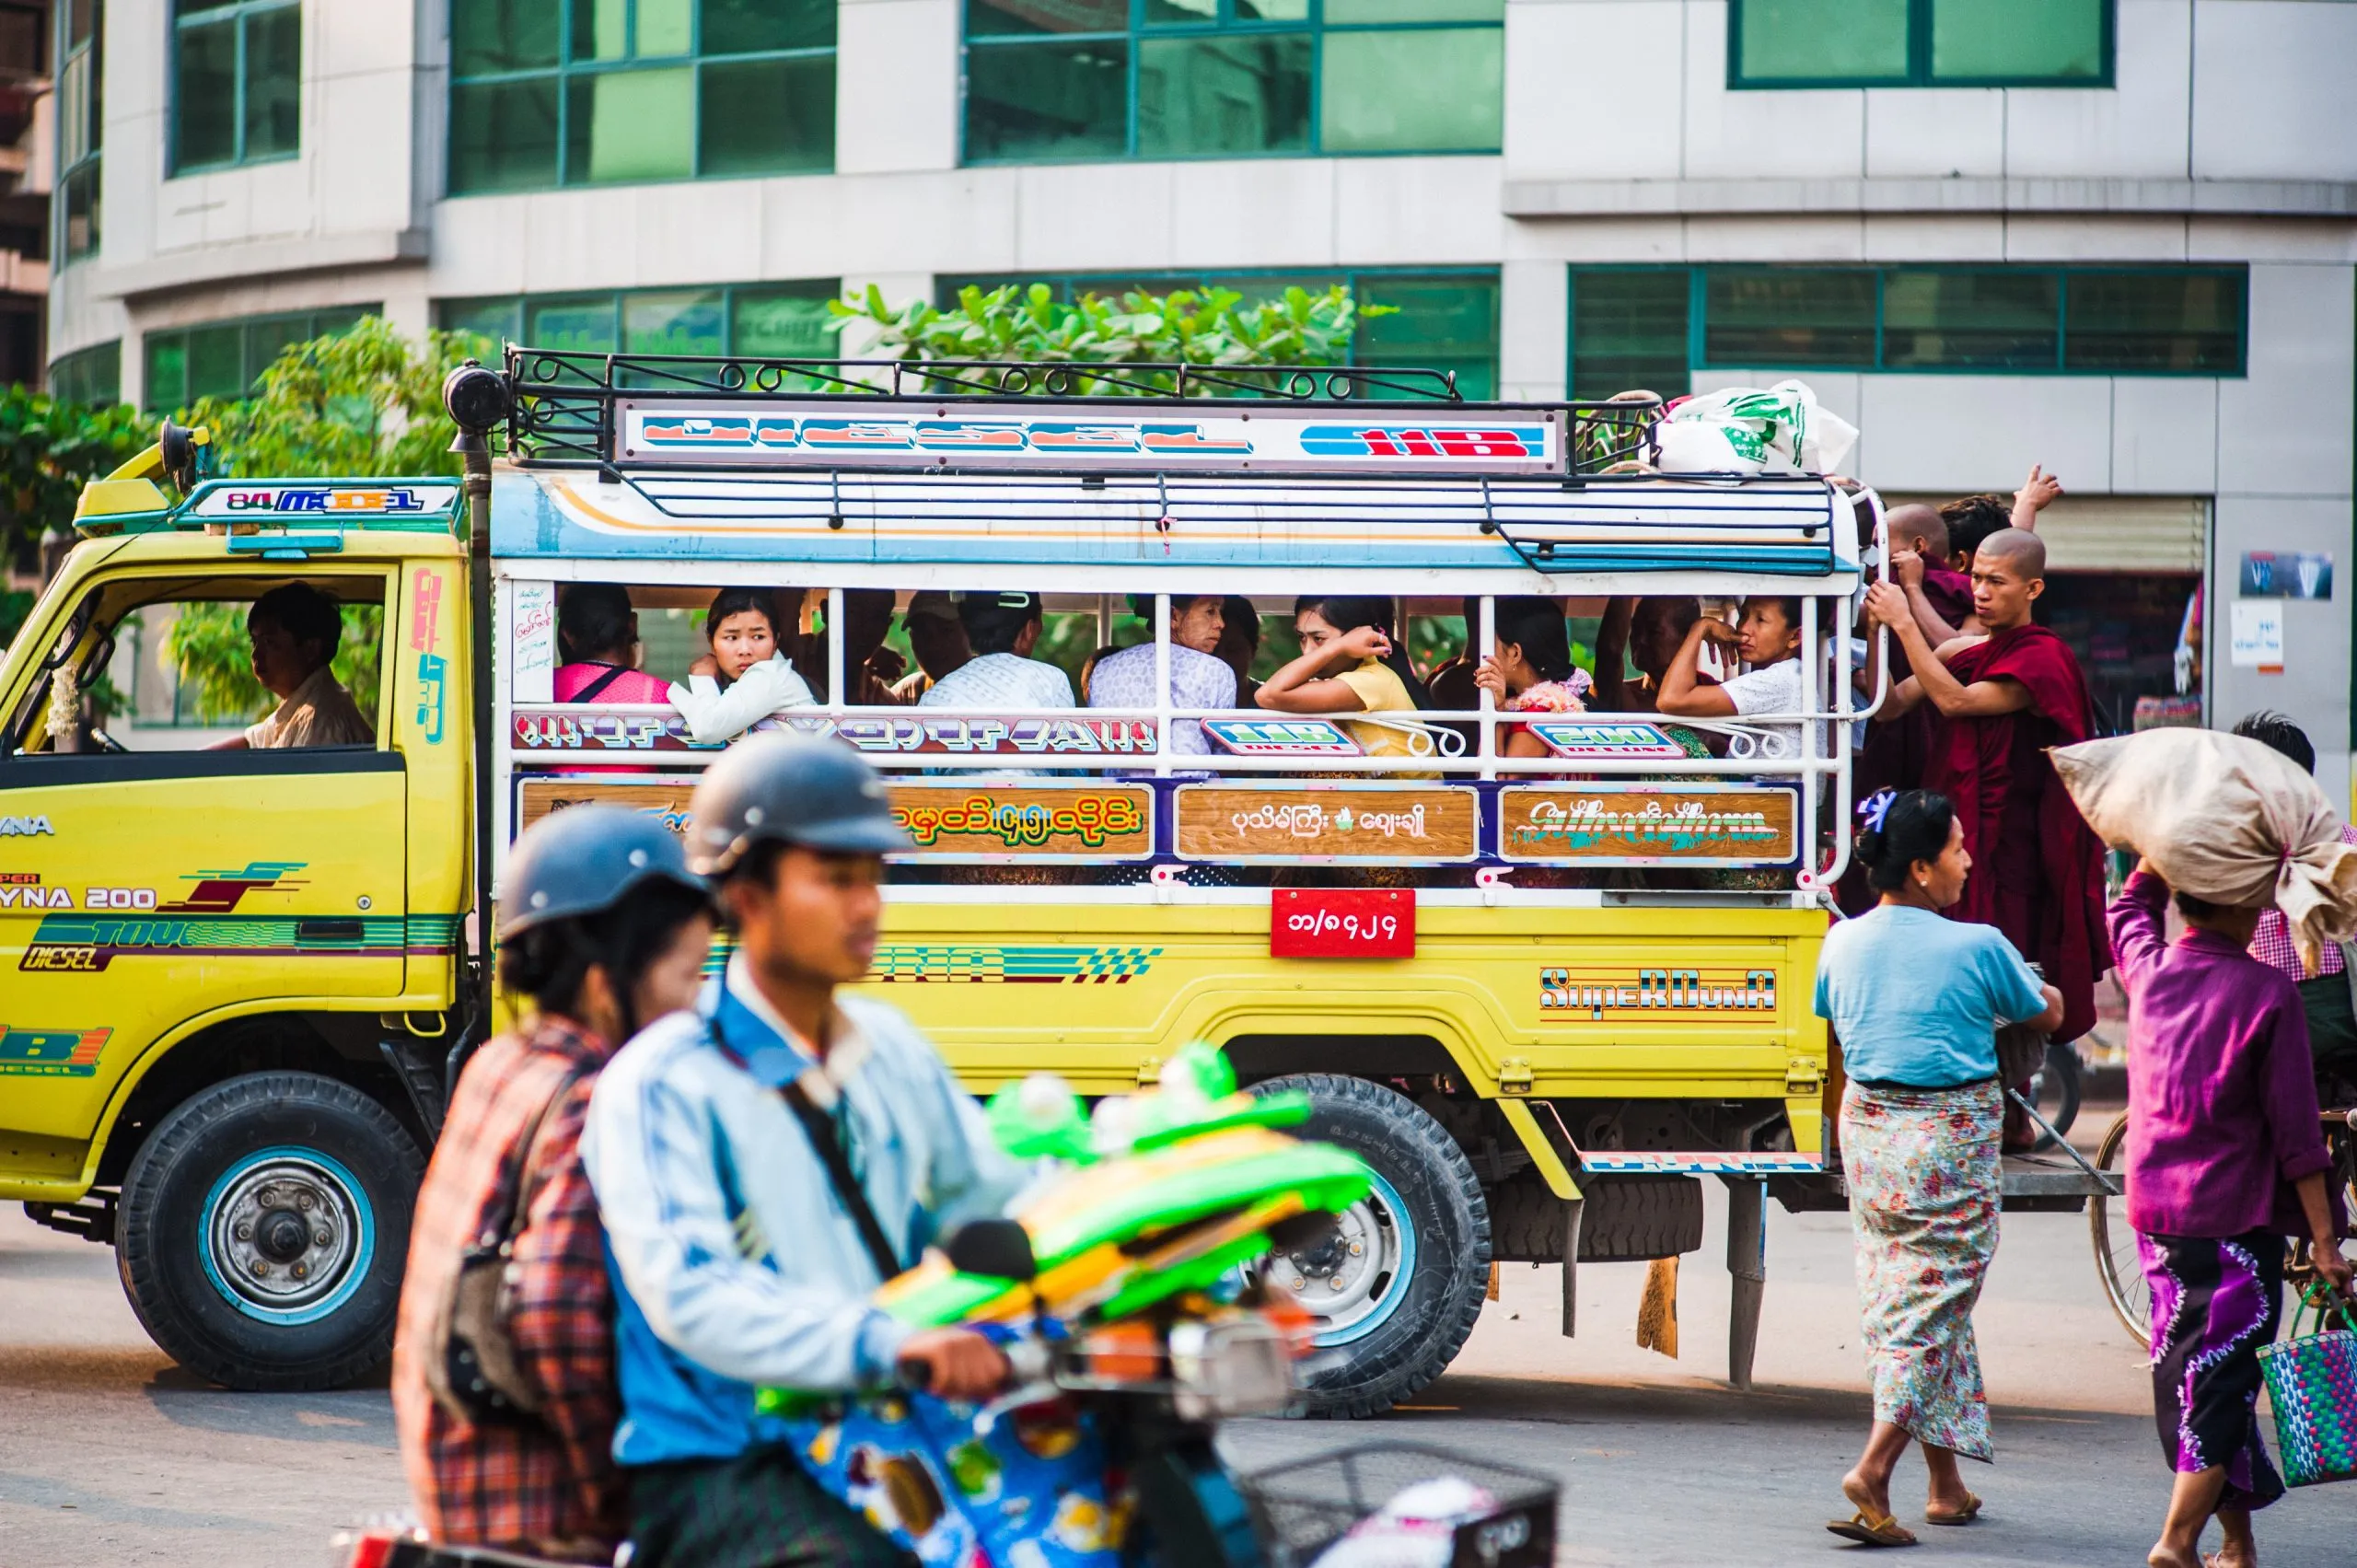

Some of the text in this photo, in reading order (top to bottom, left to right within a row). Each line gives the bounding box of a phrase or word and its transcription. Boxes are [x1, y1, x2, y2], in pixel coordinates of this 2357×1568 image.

[643, 416, 1254, 454] DIESEL
[226, 493, 273, 510] 84
[1220, 723, 1338, 744] 11B
[1545, 726, 1658, 745] 200
[85, 887, 157, 909] 200
[24, 947, 98, 969] DIESEL
